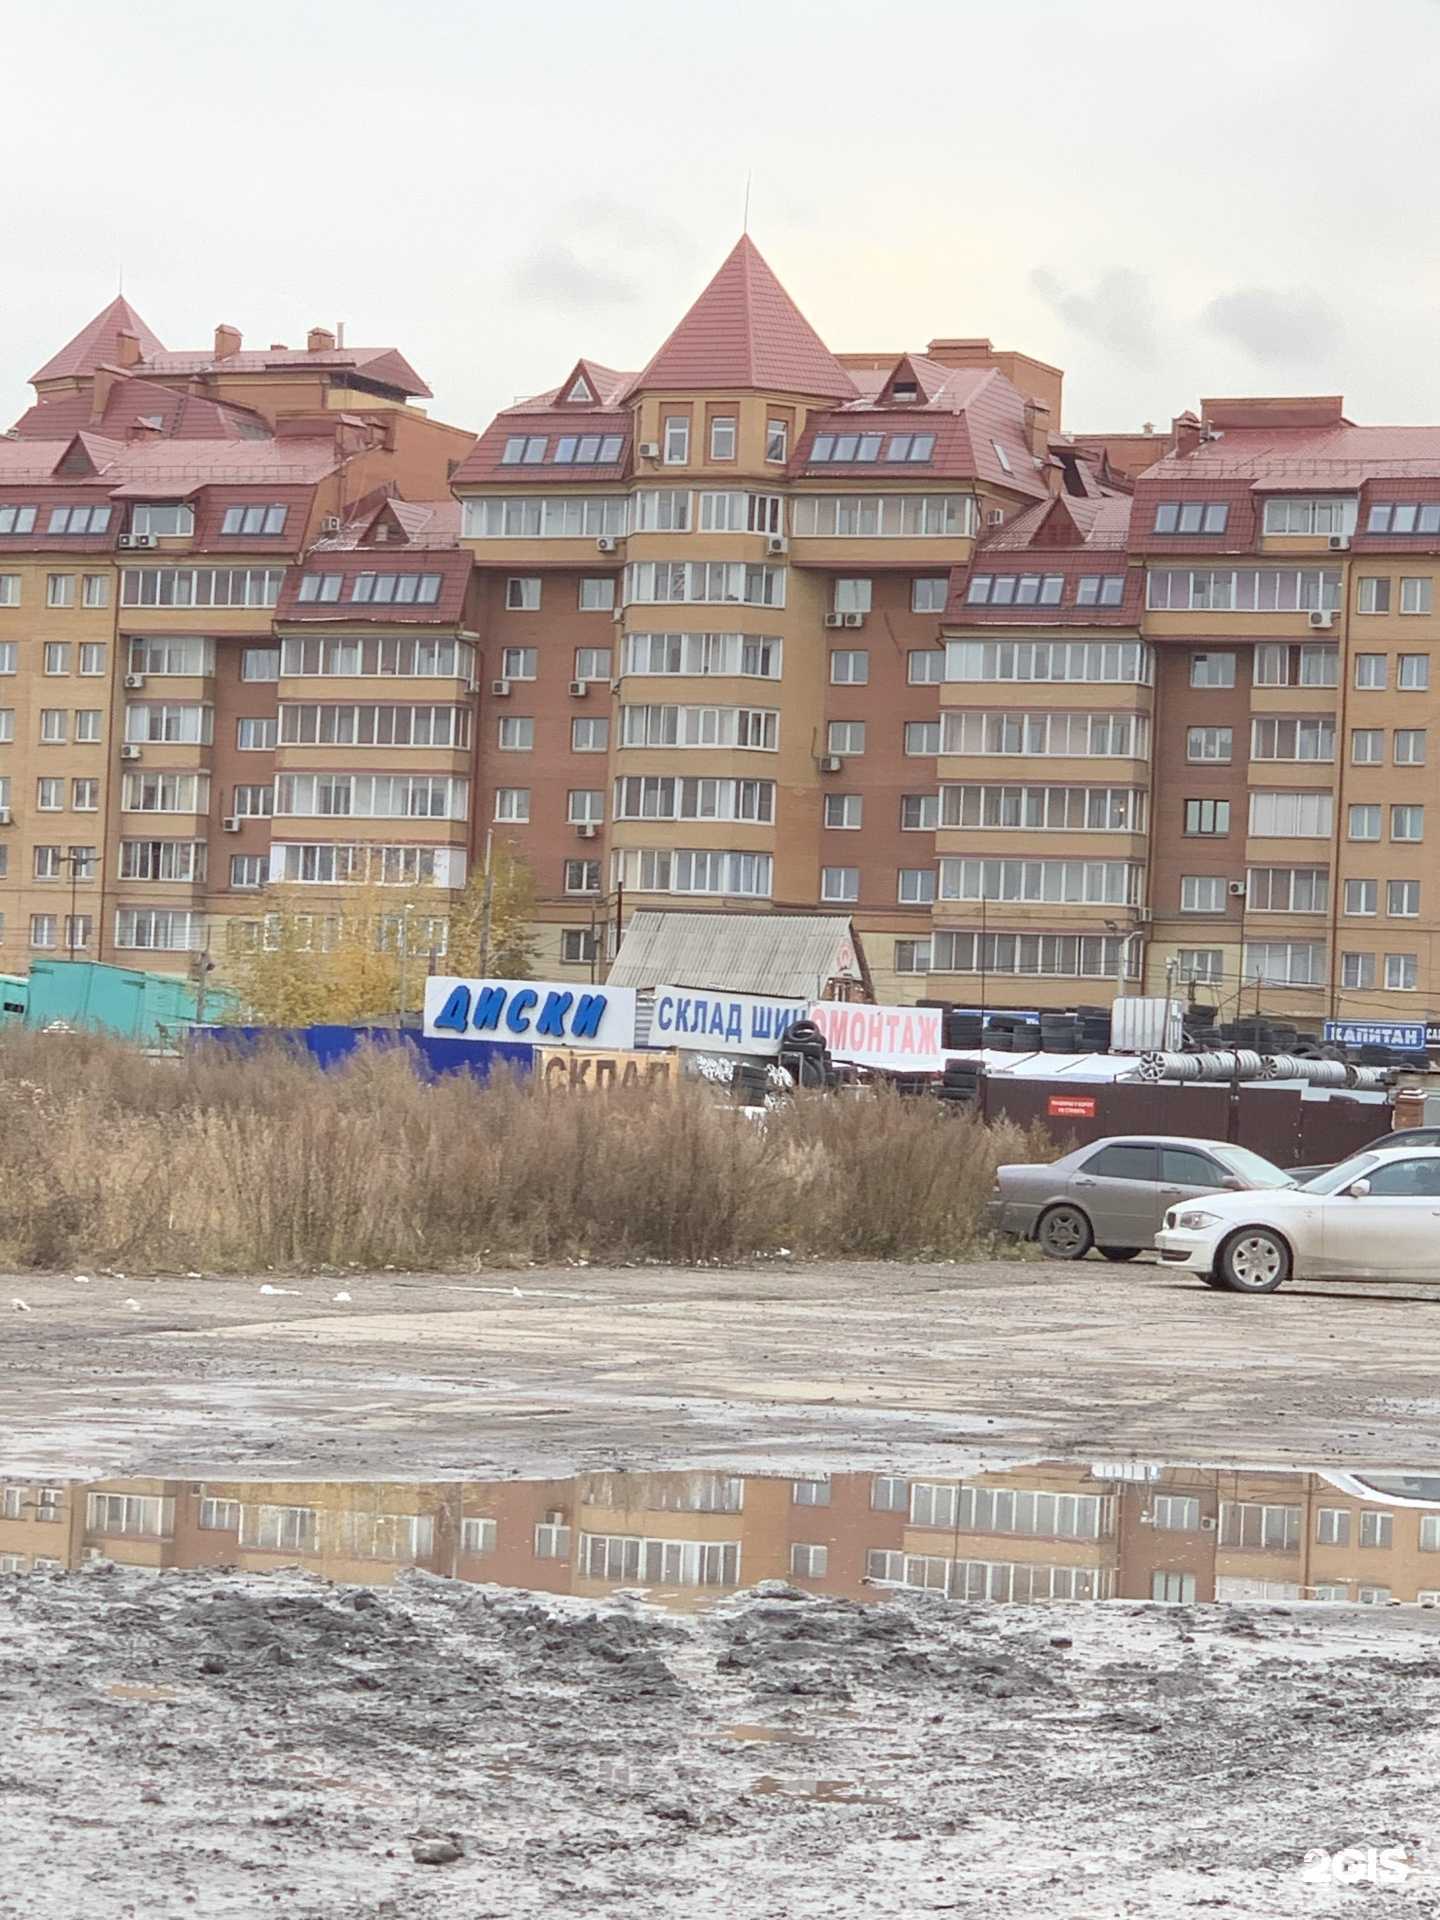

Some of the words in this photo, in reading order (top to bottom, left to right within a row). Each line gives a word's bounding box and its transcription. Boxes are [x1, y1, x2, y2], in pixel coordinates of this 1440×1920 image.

[434, 985, 608, 1039] ДИСКИ
[658, 996, 743, 1043] СКЛАД
[1331, 1026, 1418, 1045] КАПИТАН
